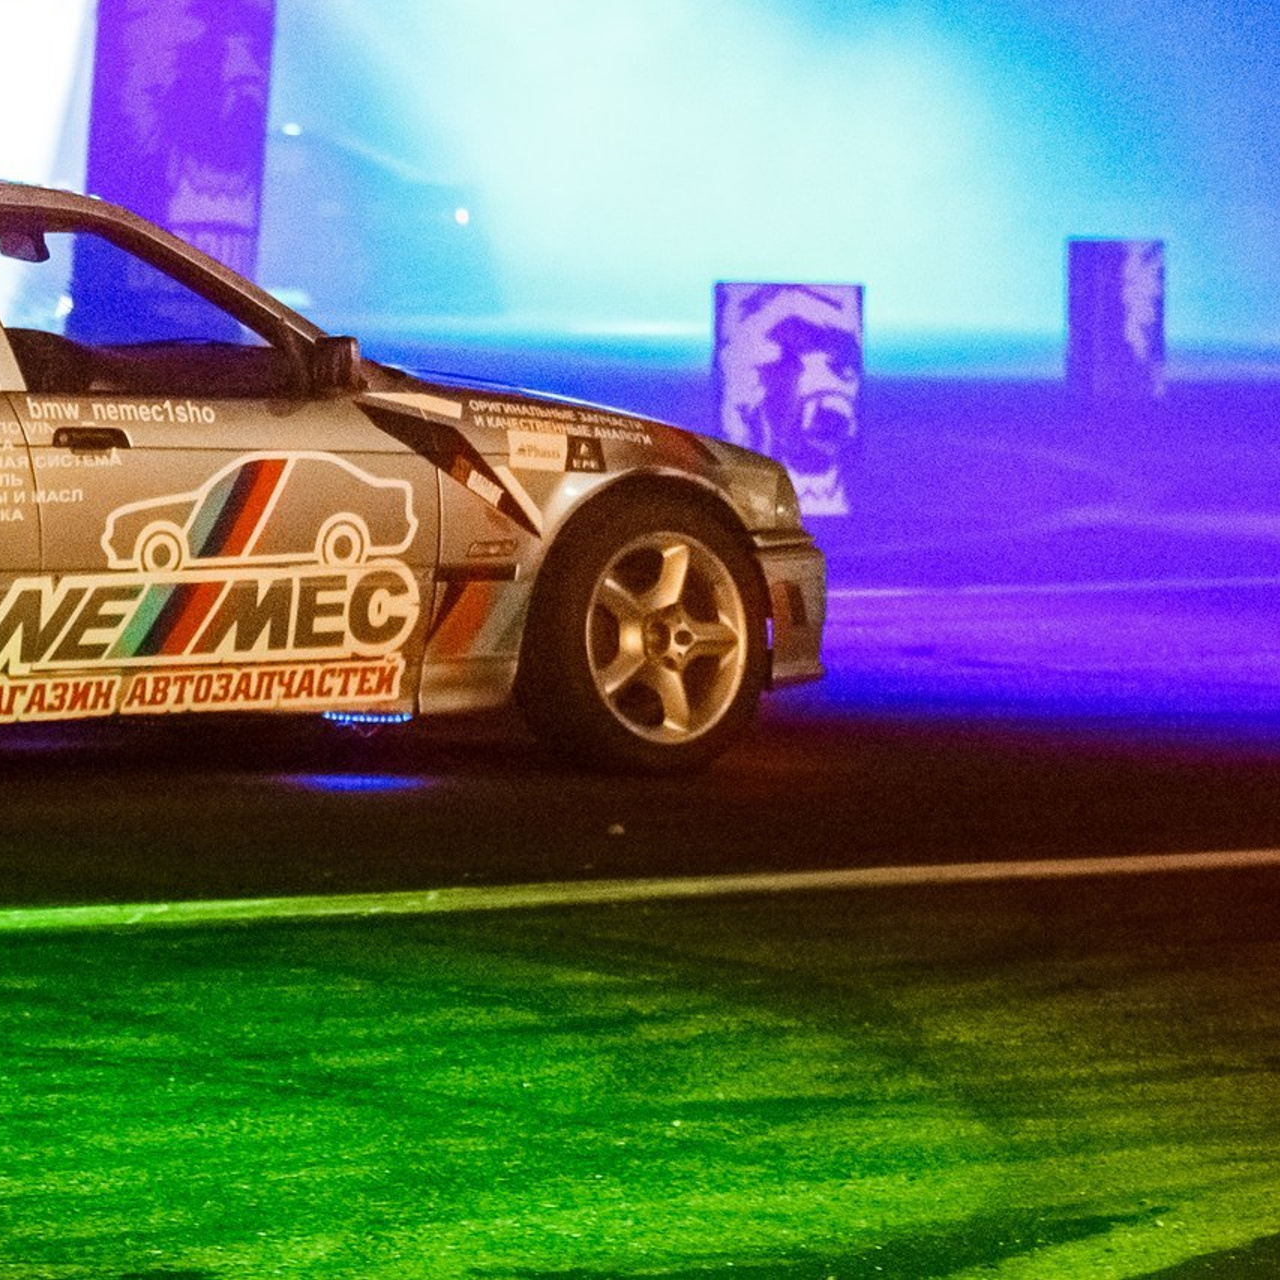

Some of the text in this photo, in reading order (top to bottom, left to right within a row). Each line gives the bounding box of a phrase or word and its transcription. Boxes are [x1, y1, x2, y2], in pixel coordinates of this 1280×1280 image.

[469, 400, 574, 422] ОРИГИНАЛЬНЫЕ
[473, 414, 652, 446] И КАЧЕСТВЕННЫЕ АНАЛОГИ
[13, 490, 26, 504] И
[124, 656, 400, 709] АВТОЗАПЧАСТЕЙ
